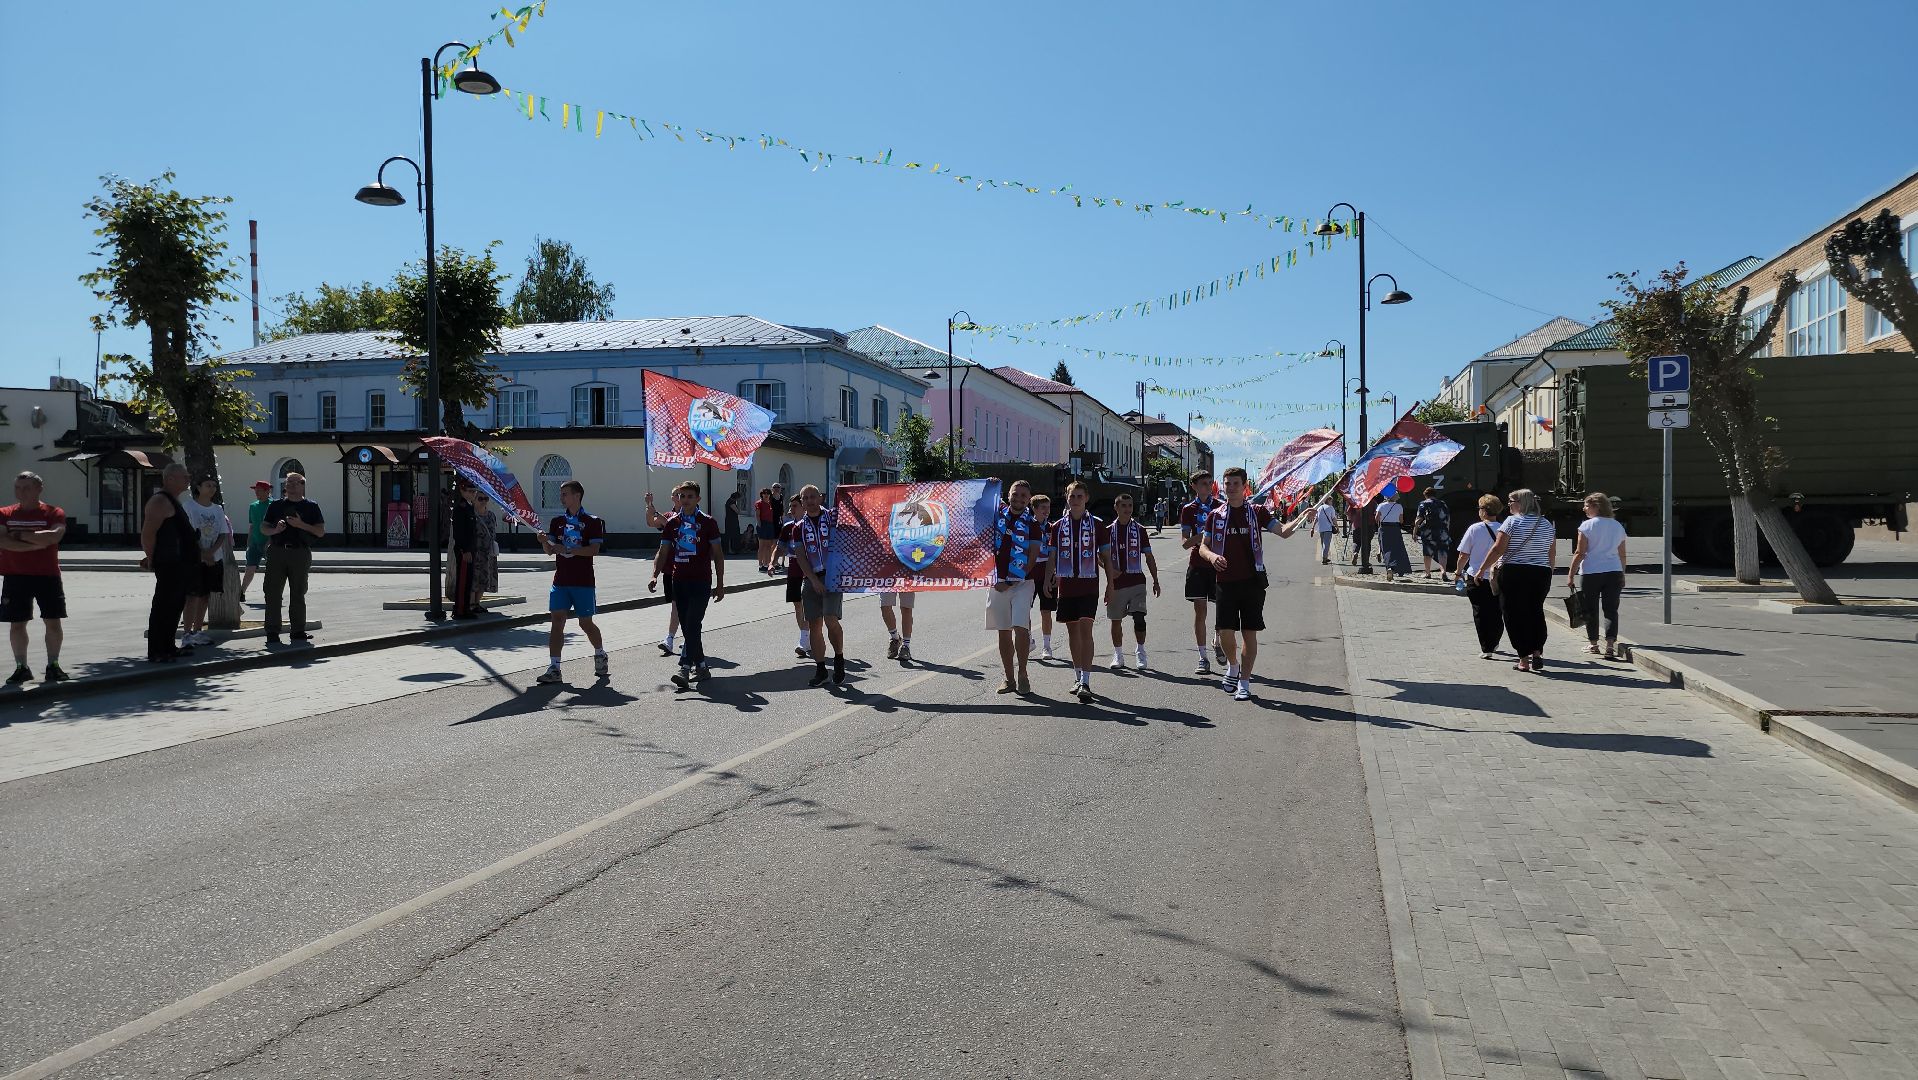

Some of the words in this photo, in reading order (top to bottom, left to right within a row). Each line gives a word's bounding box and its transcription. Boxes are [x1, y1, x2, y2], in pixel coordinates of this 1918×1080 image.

[1659, 360, 1681, 388] P
[1482, 443, 1490, 457] 2
[1432, 475, 1445, 490] Z
